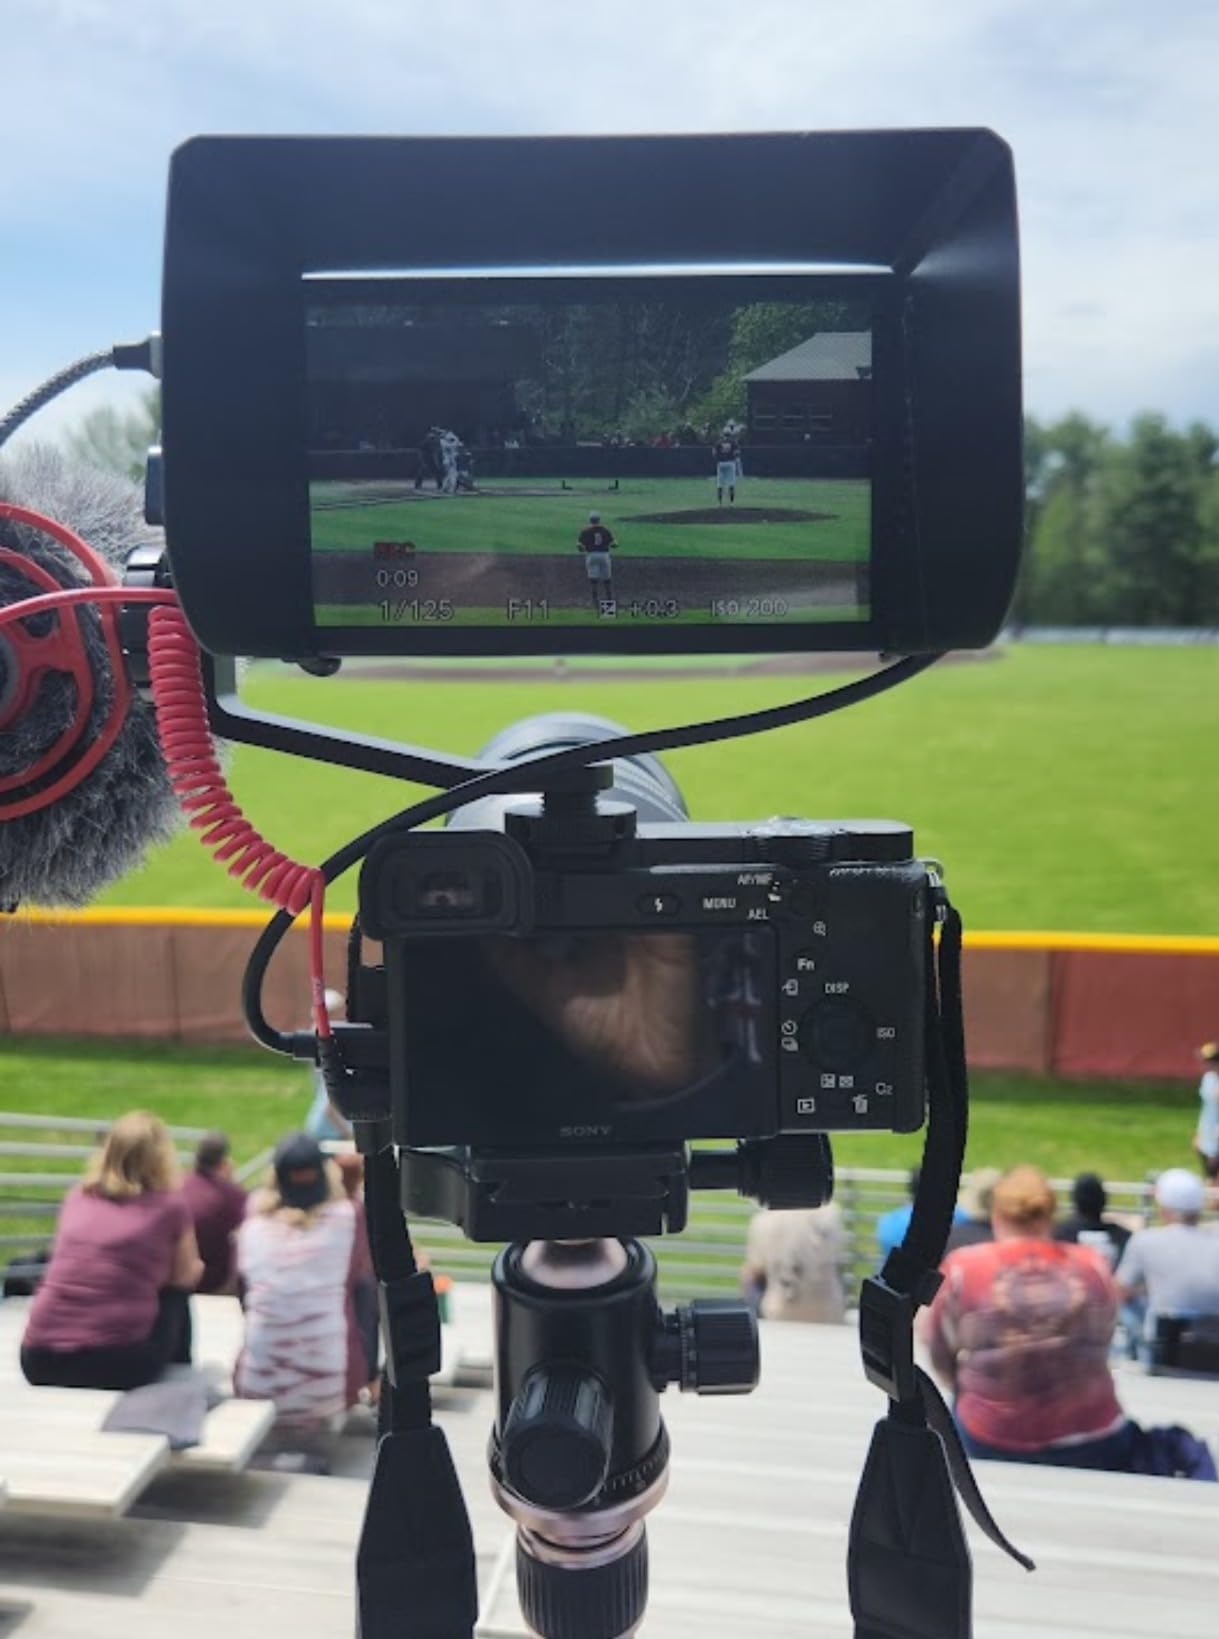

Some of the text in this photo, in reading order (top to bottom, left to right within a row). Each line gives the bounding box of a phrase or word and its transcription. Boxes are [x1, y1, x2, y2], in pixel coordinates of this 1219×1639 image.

[376, 569, 419, 588] 0:09
[379, 599, 454, 620] 1/125
[507, 599, 550, 620] F11
[749, 600, 788, 617] 200
[703, 898, 736, 909] MENU
[747, 908, 769, 920] AEL
[797, 958, 815, 971] Fn
[825, 982, 849, 994] DISP
[876, 1027, 896, 1039] ISO
[875, 1082, 893, 1096] C2
[560, 1125, 612, 1137] SONY
